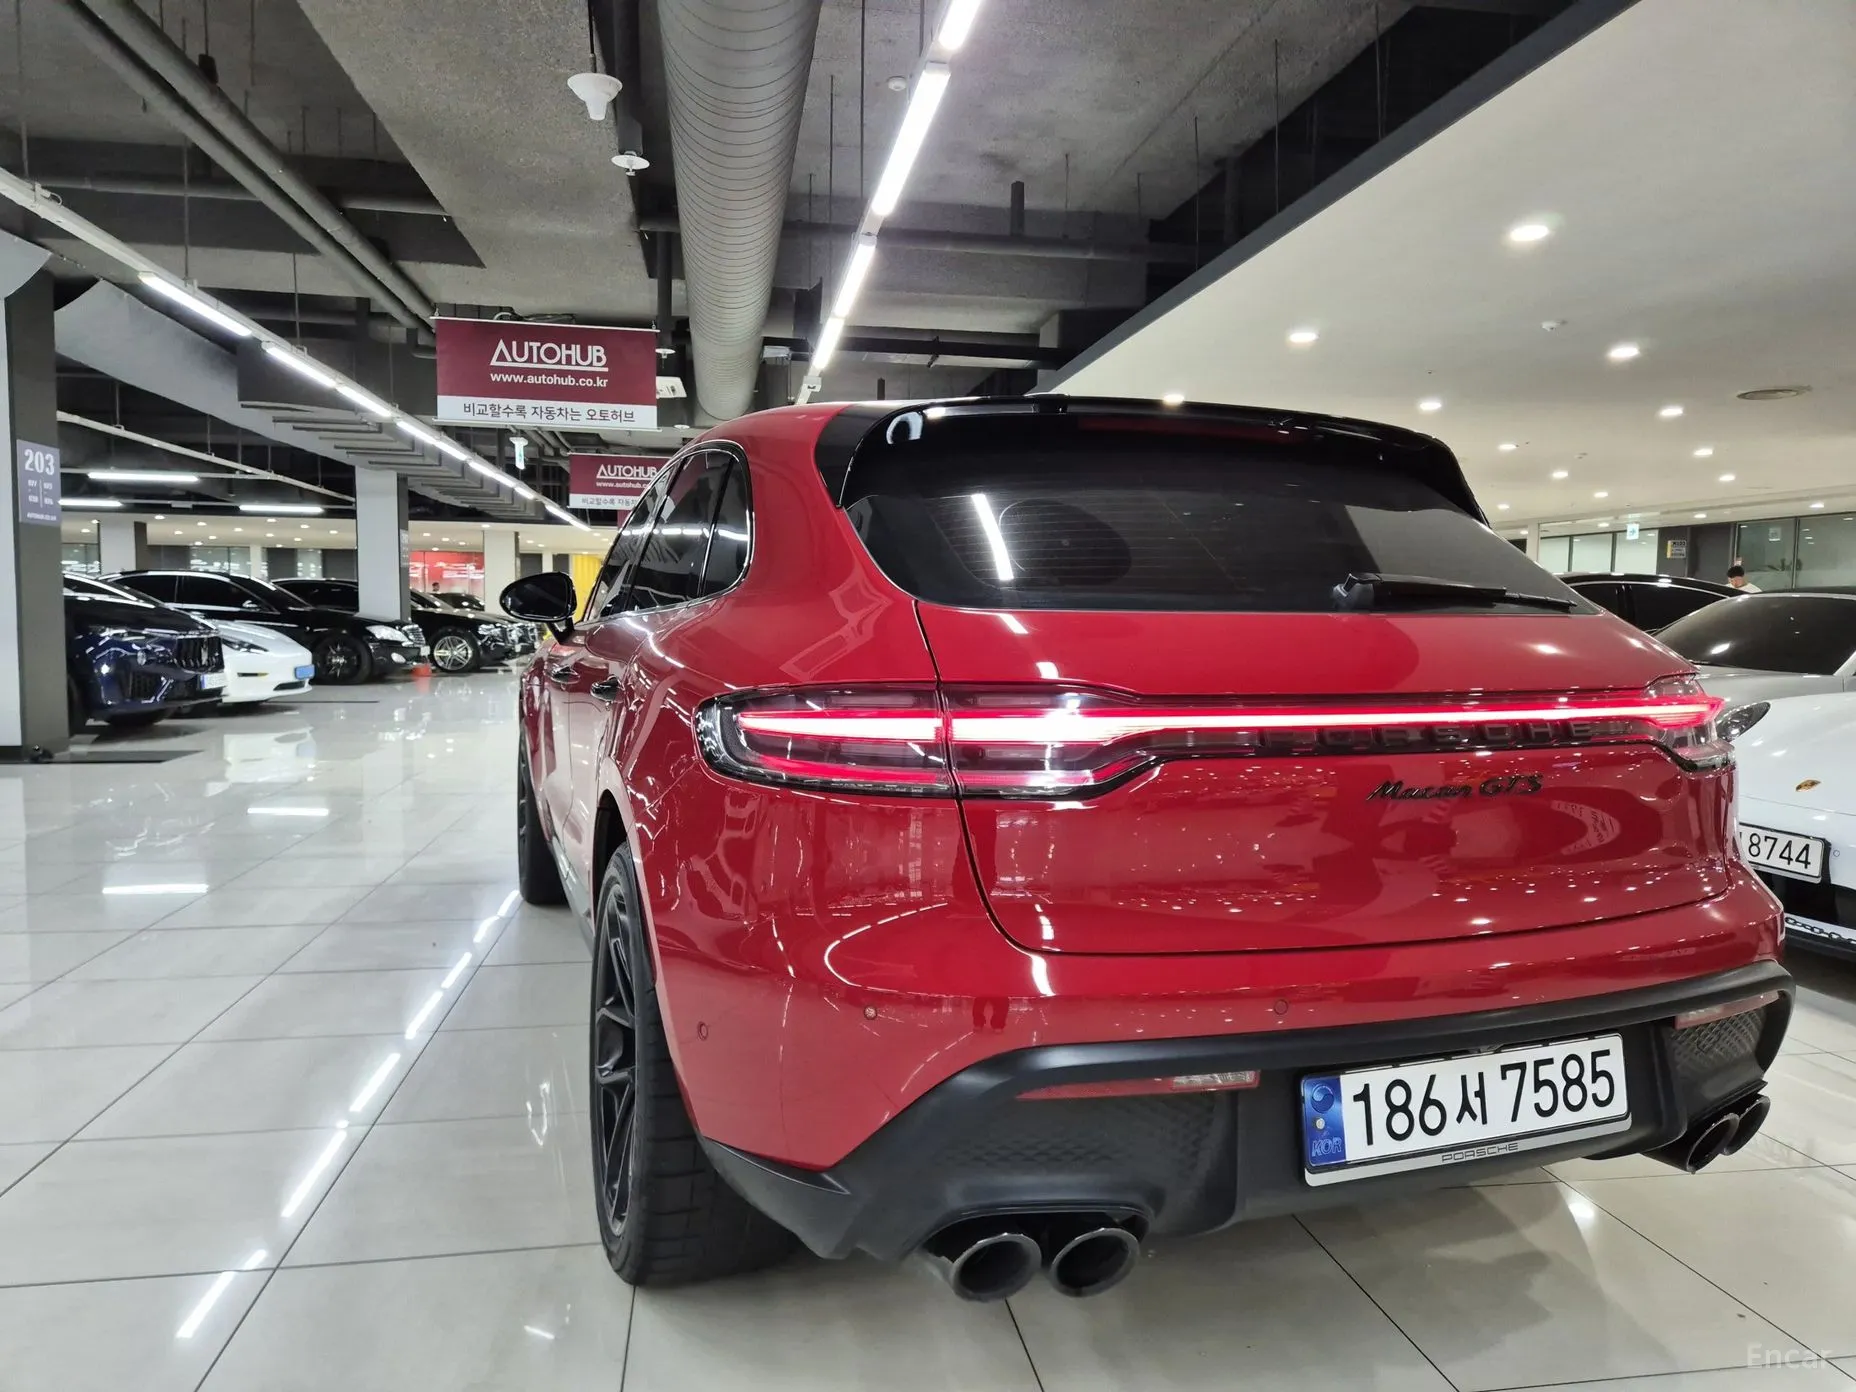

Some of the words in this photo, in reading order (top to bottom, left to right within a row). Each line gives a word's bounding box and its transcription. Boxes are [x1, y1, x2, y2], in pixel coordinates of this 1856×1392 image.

[490, 338, 609, 372] AUTOHUB
[490, 372, 608, 388] www.autohub.co.kr
[463, 402, 528, 419] 비교할수록
[531, 406, 582, 421] 자동차는
[586, 410, 636, 423] 오토허브
[24, 448, 55, 476] 203
[596, 464, 657, 480] AUTOHUB
[1366, 779, 1473, 801] Macan
[1478, 773, 1544, 797] GTS
[1748, 832, 1812, 870] 8744
[1352, 1071, 1488, 1146] 186서
[1500, 1049, 1615, 1123] 7585
[1311, 1136, 1343, 1158] KOR
[1441, 1142, 1519, 1164] PORSCHE
